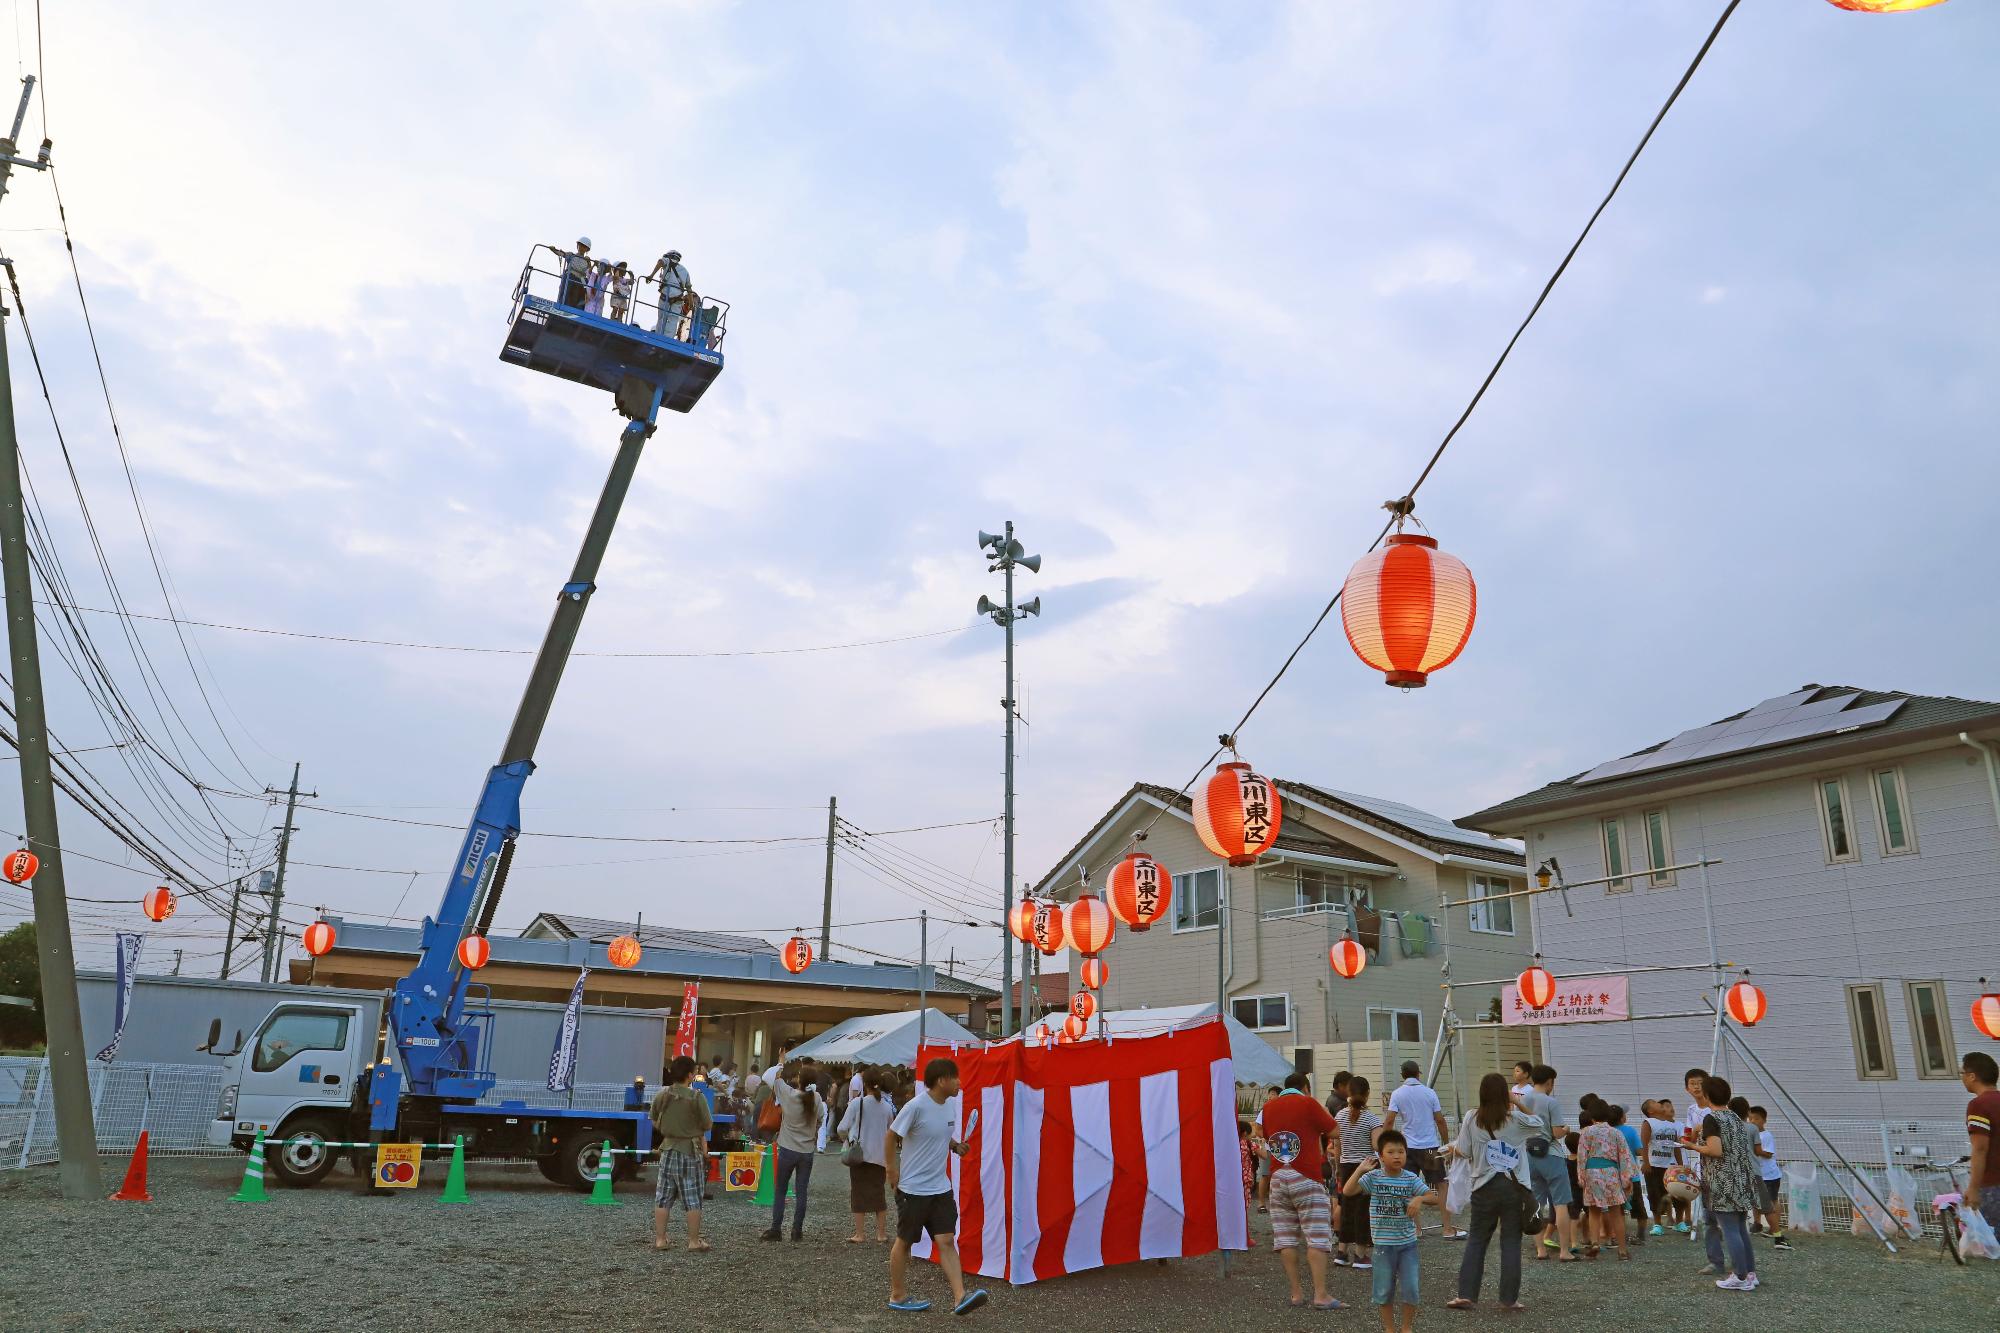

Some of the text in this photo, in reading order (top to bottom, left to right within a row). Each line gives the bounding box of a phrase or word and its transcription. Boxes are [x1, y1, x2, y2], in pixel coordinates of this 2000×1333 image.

[1240, 772, 1272, 844] 玉川東区
[464, 832, 487, 877] AICHI
[1134, 859, 1159, 916] 玉川東区
[1034, 907, 1050, 945] 玉川東区
[1515, 992, 1610, 1010] 玉区納涼祭
